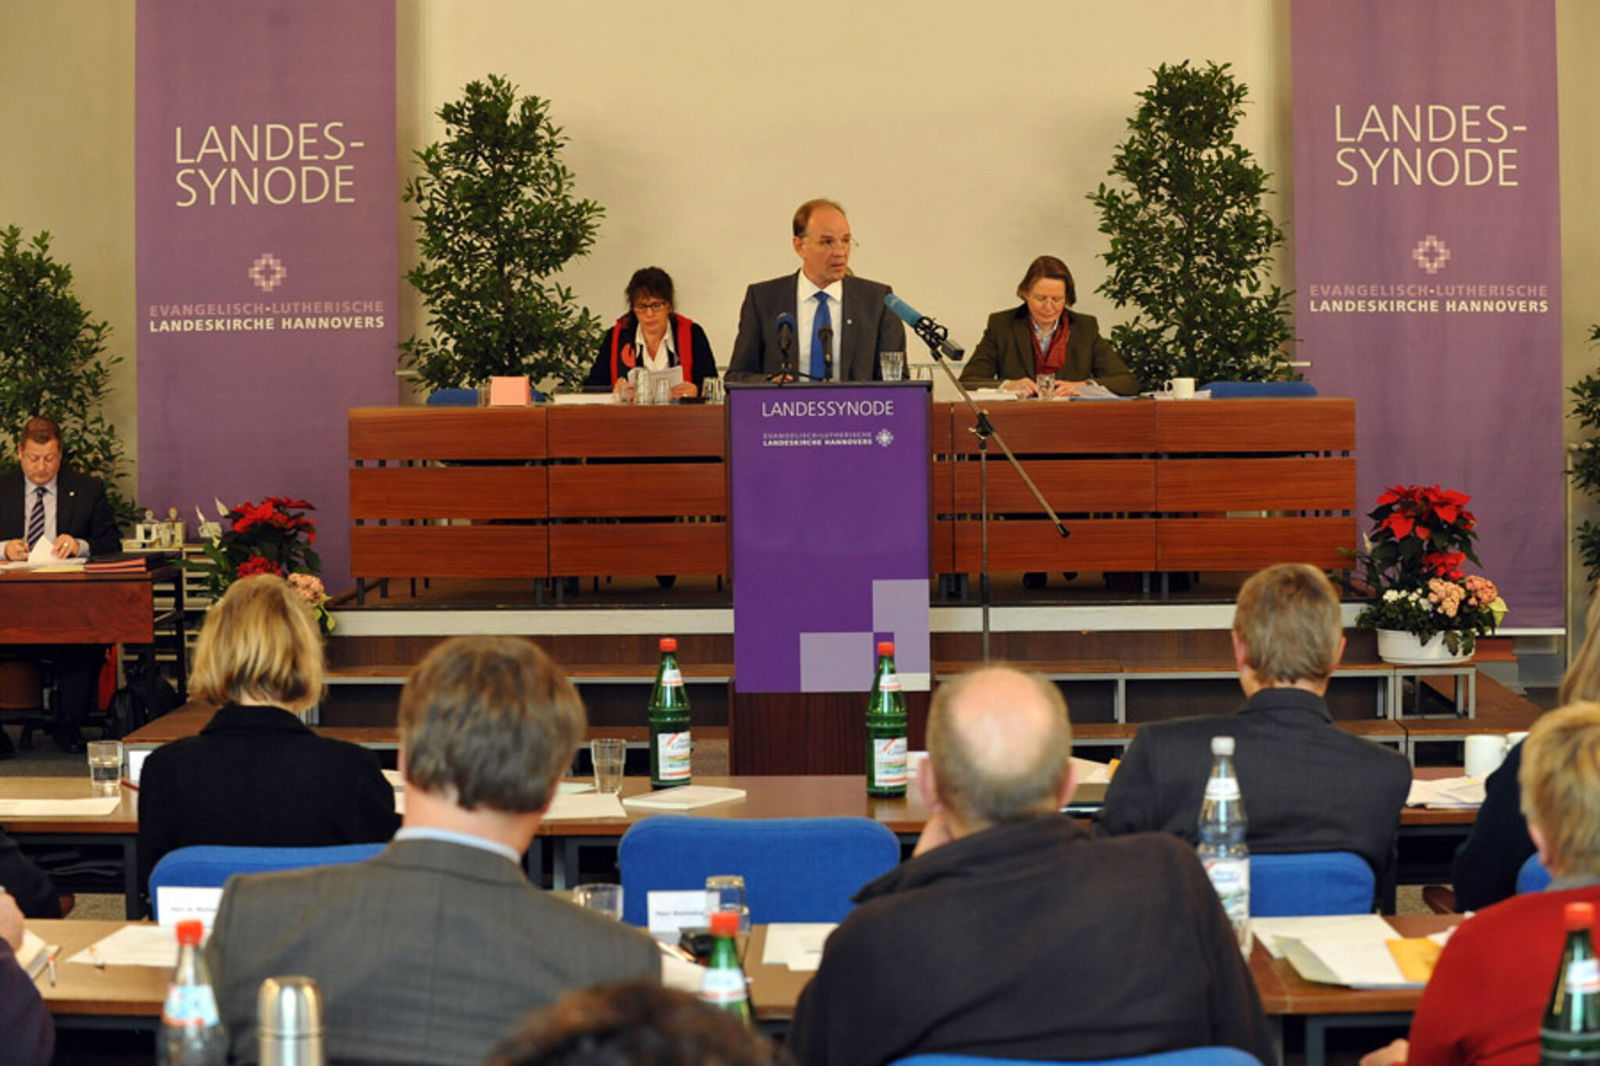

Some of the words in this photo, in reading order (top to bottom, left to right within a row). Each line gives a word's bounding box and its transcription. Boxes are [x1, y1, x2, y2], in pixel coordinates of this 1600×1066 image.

[1335, 104, 1528, 144] LANDES-
[175, 121, 365, 164] LANDES-
[1335, 147, 1519, 187] SYNODE
[175, 164, 356, 208] SYNODE
[1309, 299, 1440, 313] LANDESKIRCHE
[1445, 299, 1549, 313] HANNOVERS
[149, 317, 275, 333] LANDESKIRCHE
[281, 315, 385, 331] HANNOVERS
[761, 400, 895, 417] LANDESSYNODE
[762, 439, 822, 447] LANDESKIRCHE
[824, 438, 872, 446] HANNOVERS
